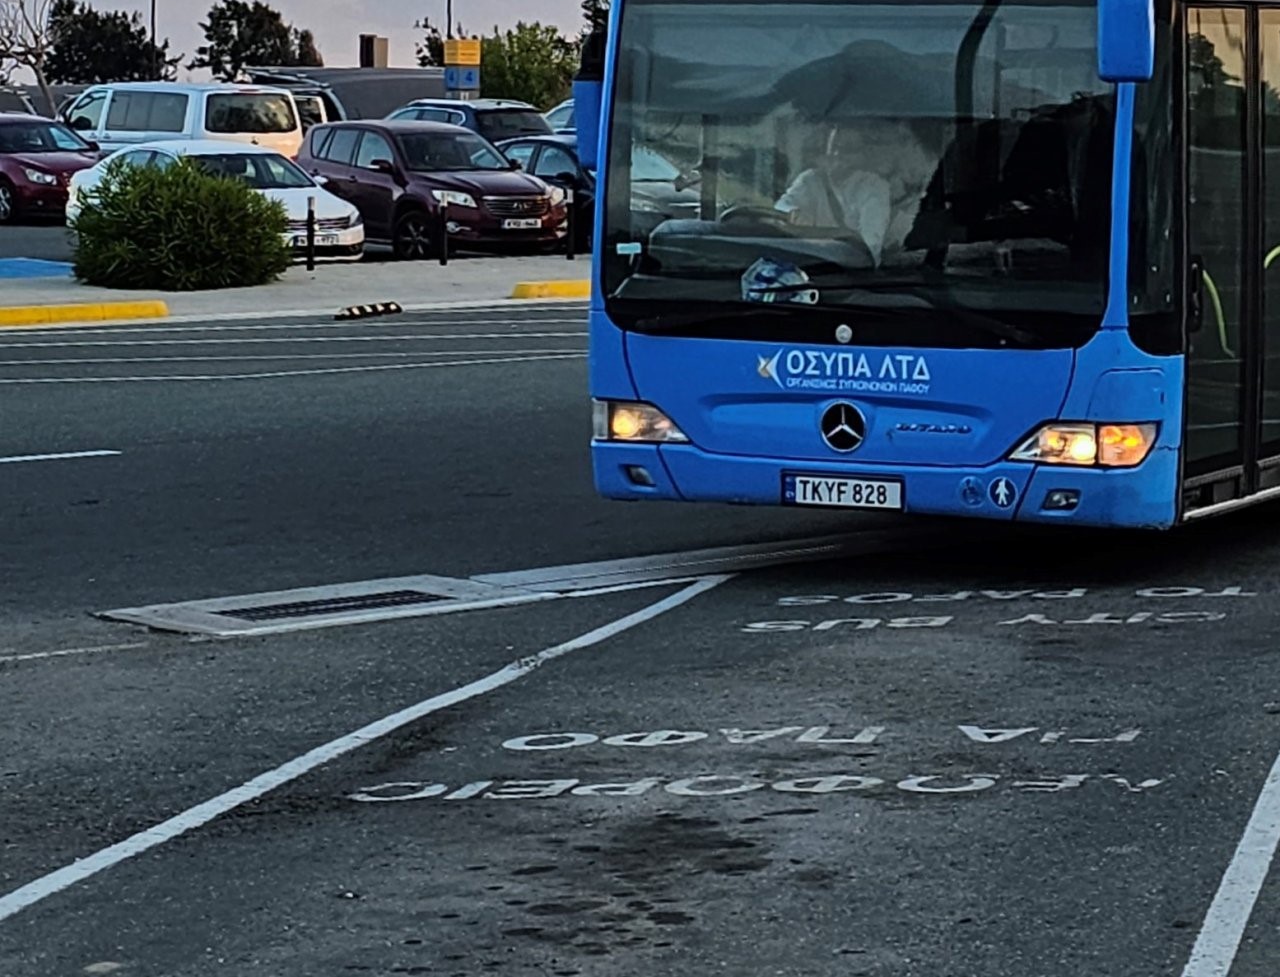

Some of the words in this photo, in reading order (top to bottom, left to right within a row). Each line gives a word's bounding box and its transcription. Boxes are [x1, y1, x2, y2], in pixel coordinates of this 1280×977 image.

[786, 350, 872, 378] ΟΣΥΠΑ
[879, 354, 931, 381] ΛΤΔ
[799, 479, 848, 503] TKYF
[852, 483, 887, 505] 828
[777, 588, 1087, 606] PAFOS
[1135, 586, 1258, 598] TO
[740, 614, 954, 633] BUS
[997, 612, 1227, 626] CITY
[501, 725, 887, 751] ΠΑΦΟ
